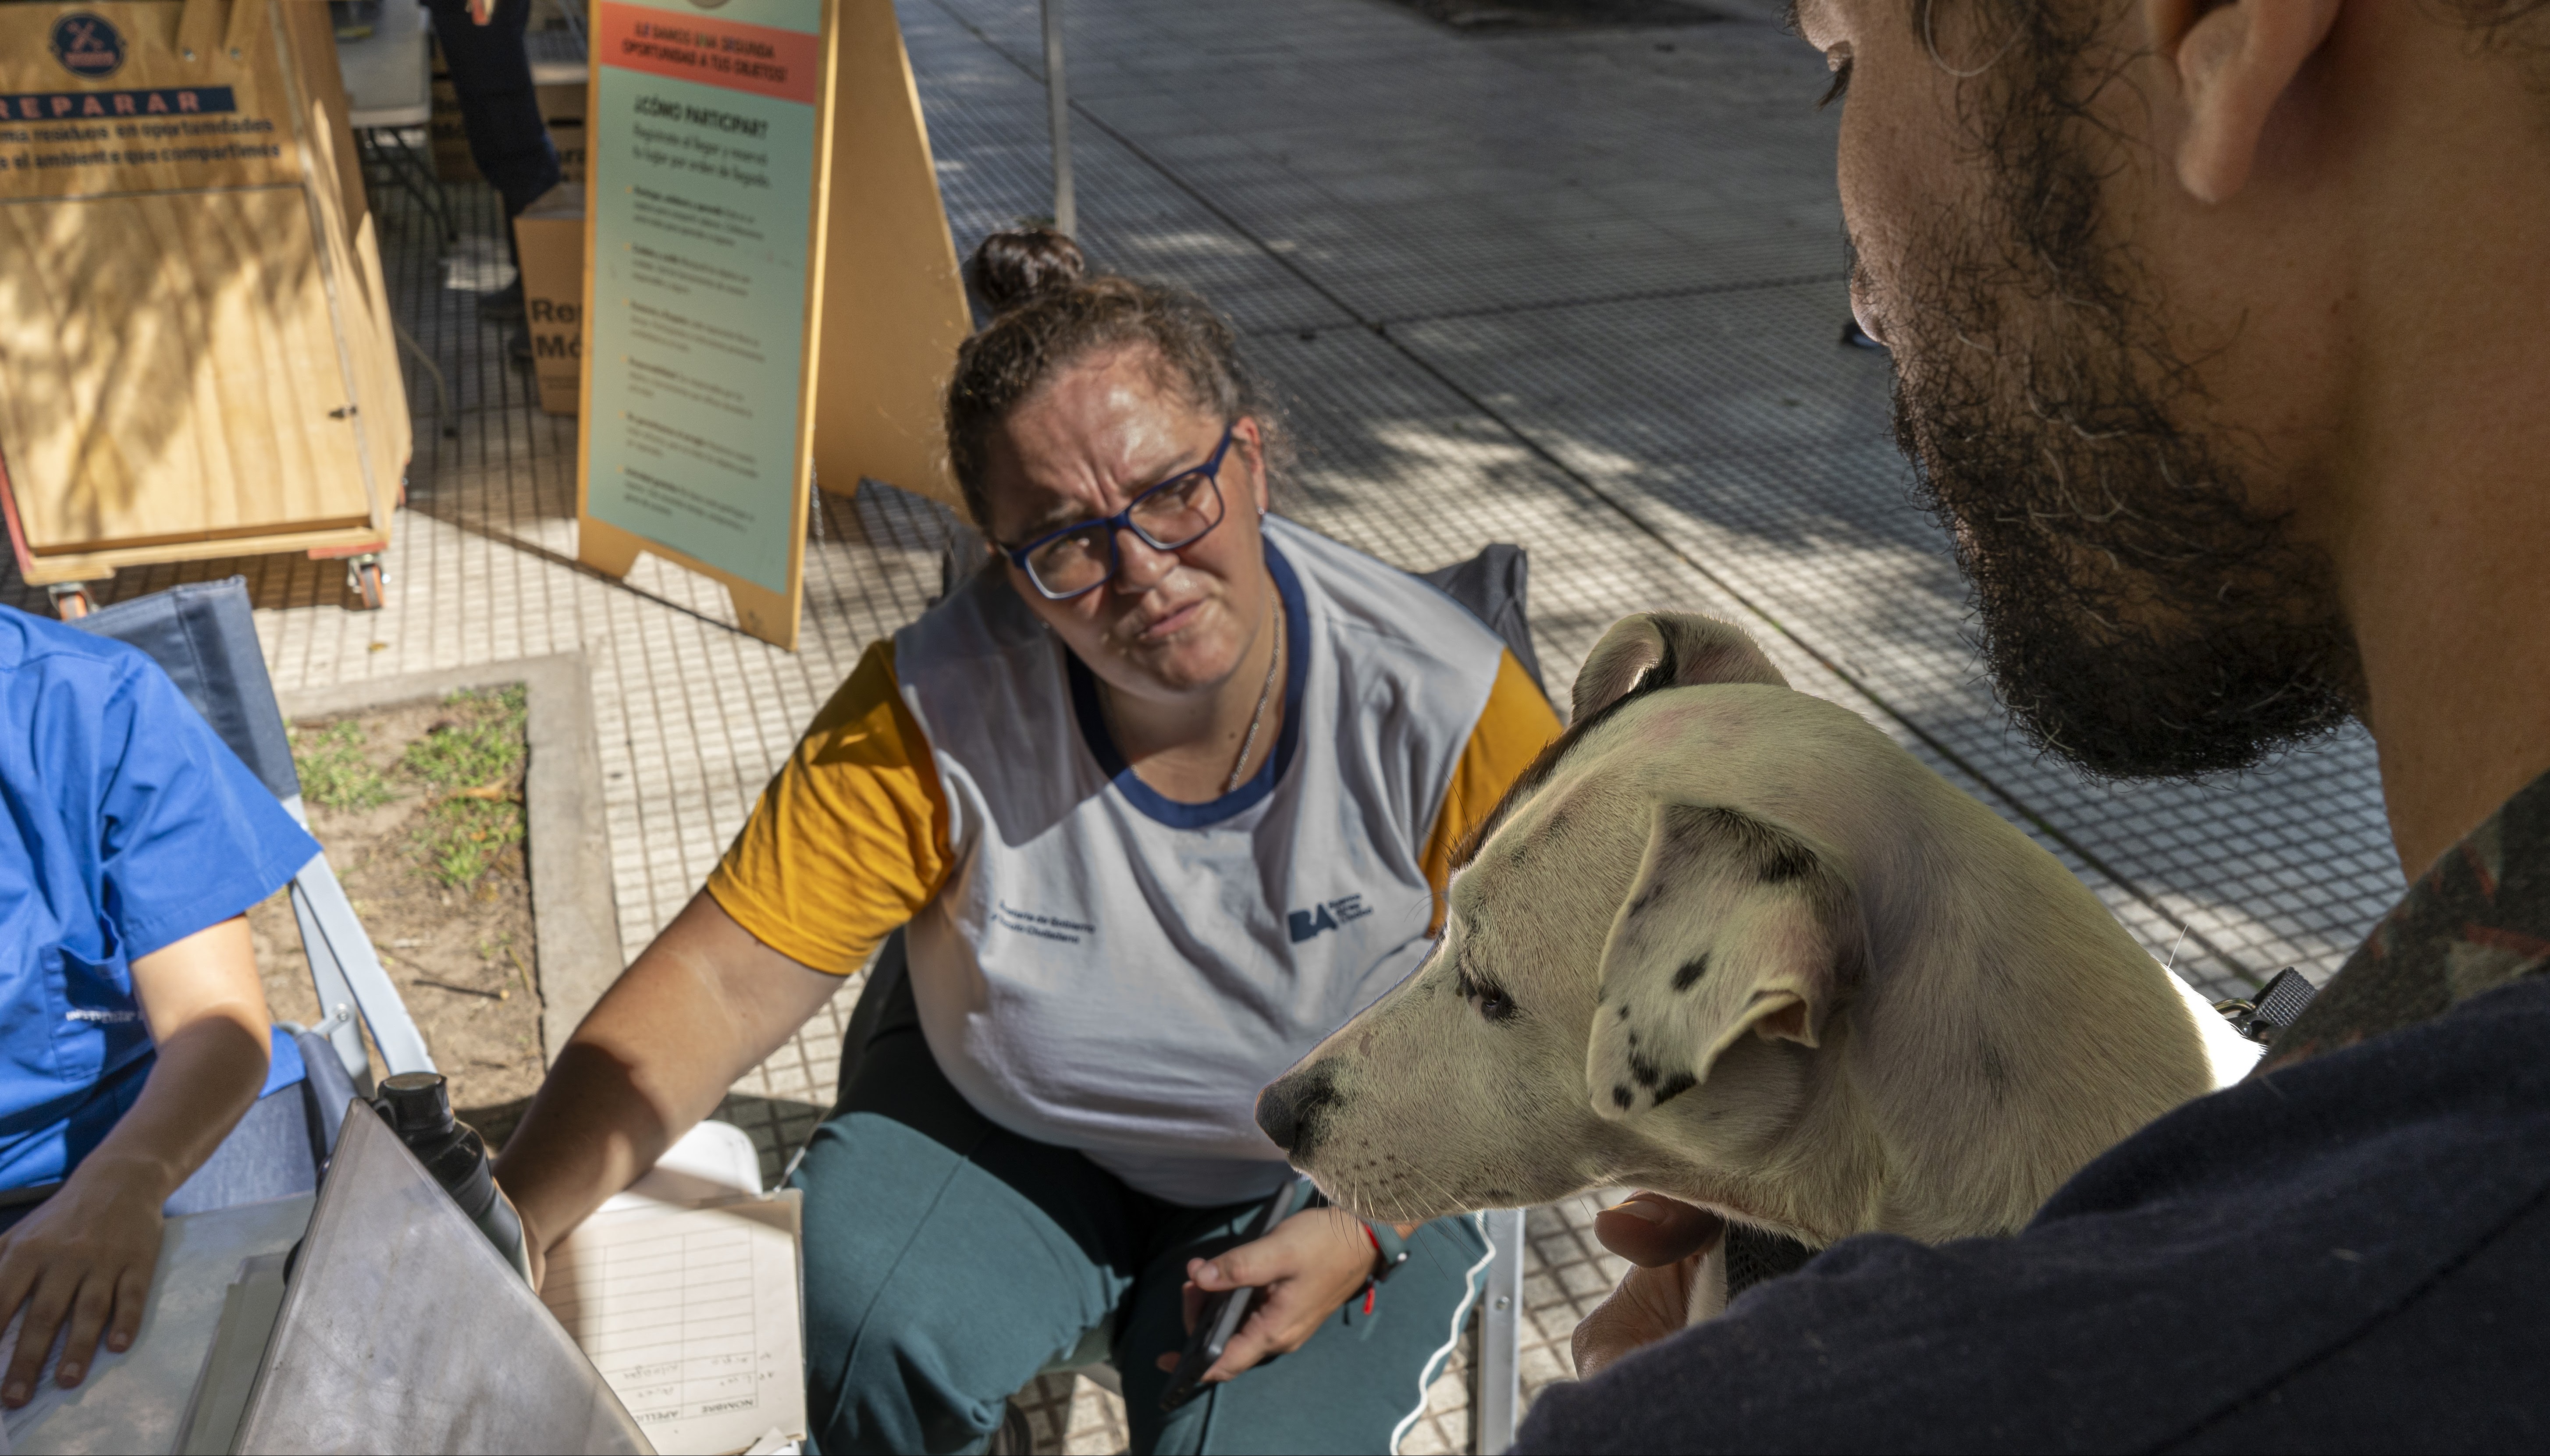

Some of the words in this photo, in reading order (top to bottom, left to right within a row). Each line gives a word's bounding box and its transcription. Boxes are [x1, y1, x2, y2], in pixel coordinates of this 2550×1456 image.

[623, 37, 696, 66] OPORTUNIDAD
[699, 52, 708, 67] A
[710, 53, 731, 73] TUS
[695, 32, 717, 48] UNA
[722, 35, 775, 59] SEGUNDA
[115, 124, 139, 139] en
[141, 117, 274, 139] oportunidades
[634, 95, 681, 121] ¿CÓMO
[685, 105, 769, 139] PARTICIPAR?
[13, 151, 30, 171] el
[35, 149, 120, 169] ambiente
[124, 149, 158, 166] que
[160, 141, 280, 164] compartimos
[1287, 901, 1339, 945] BA
[702, 1398, 754, 1413] NOMBRE
